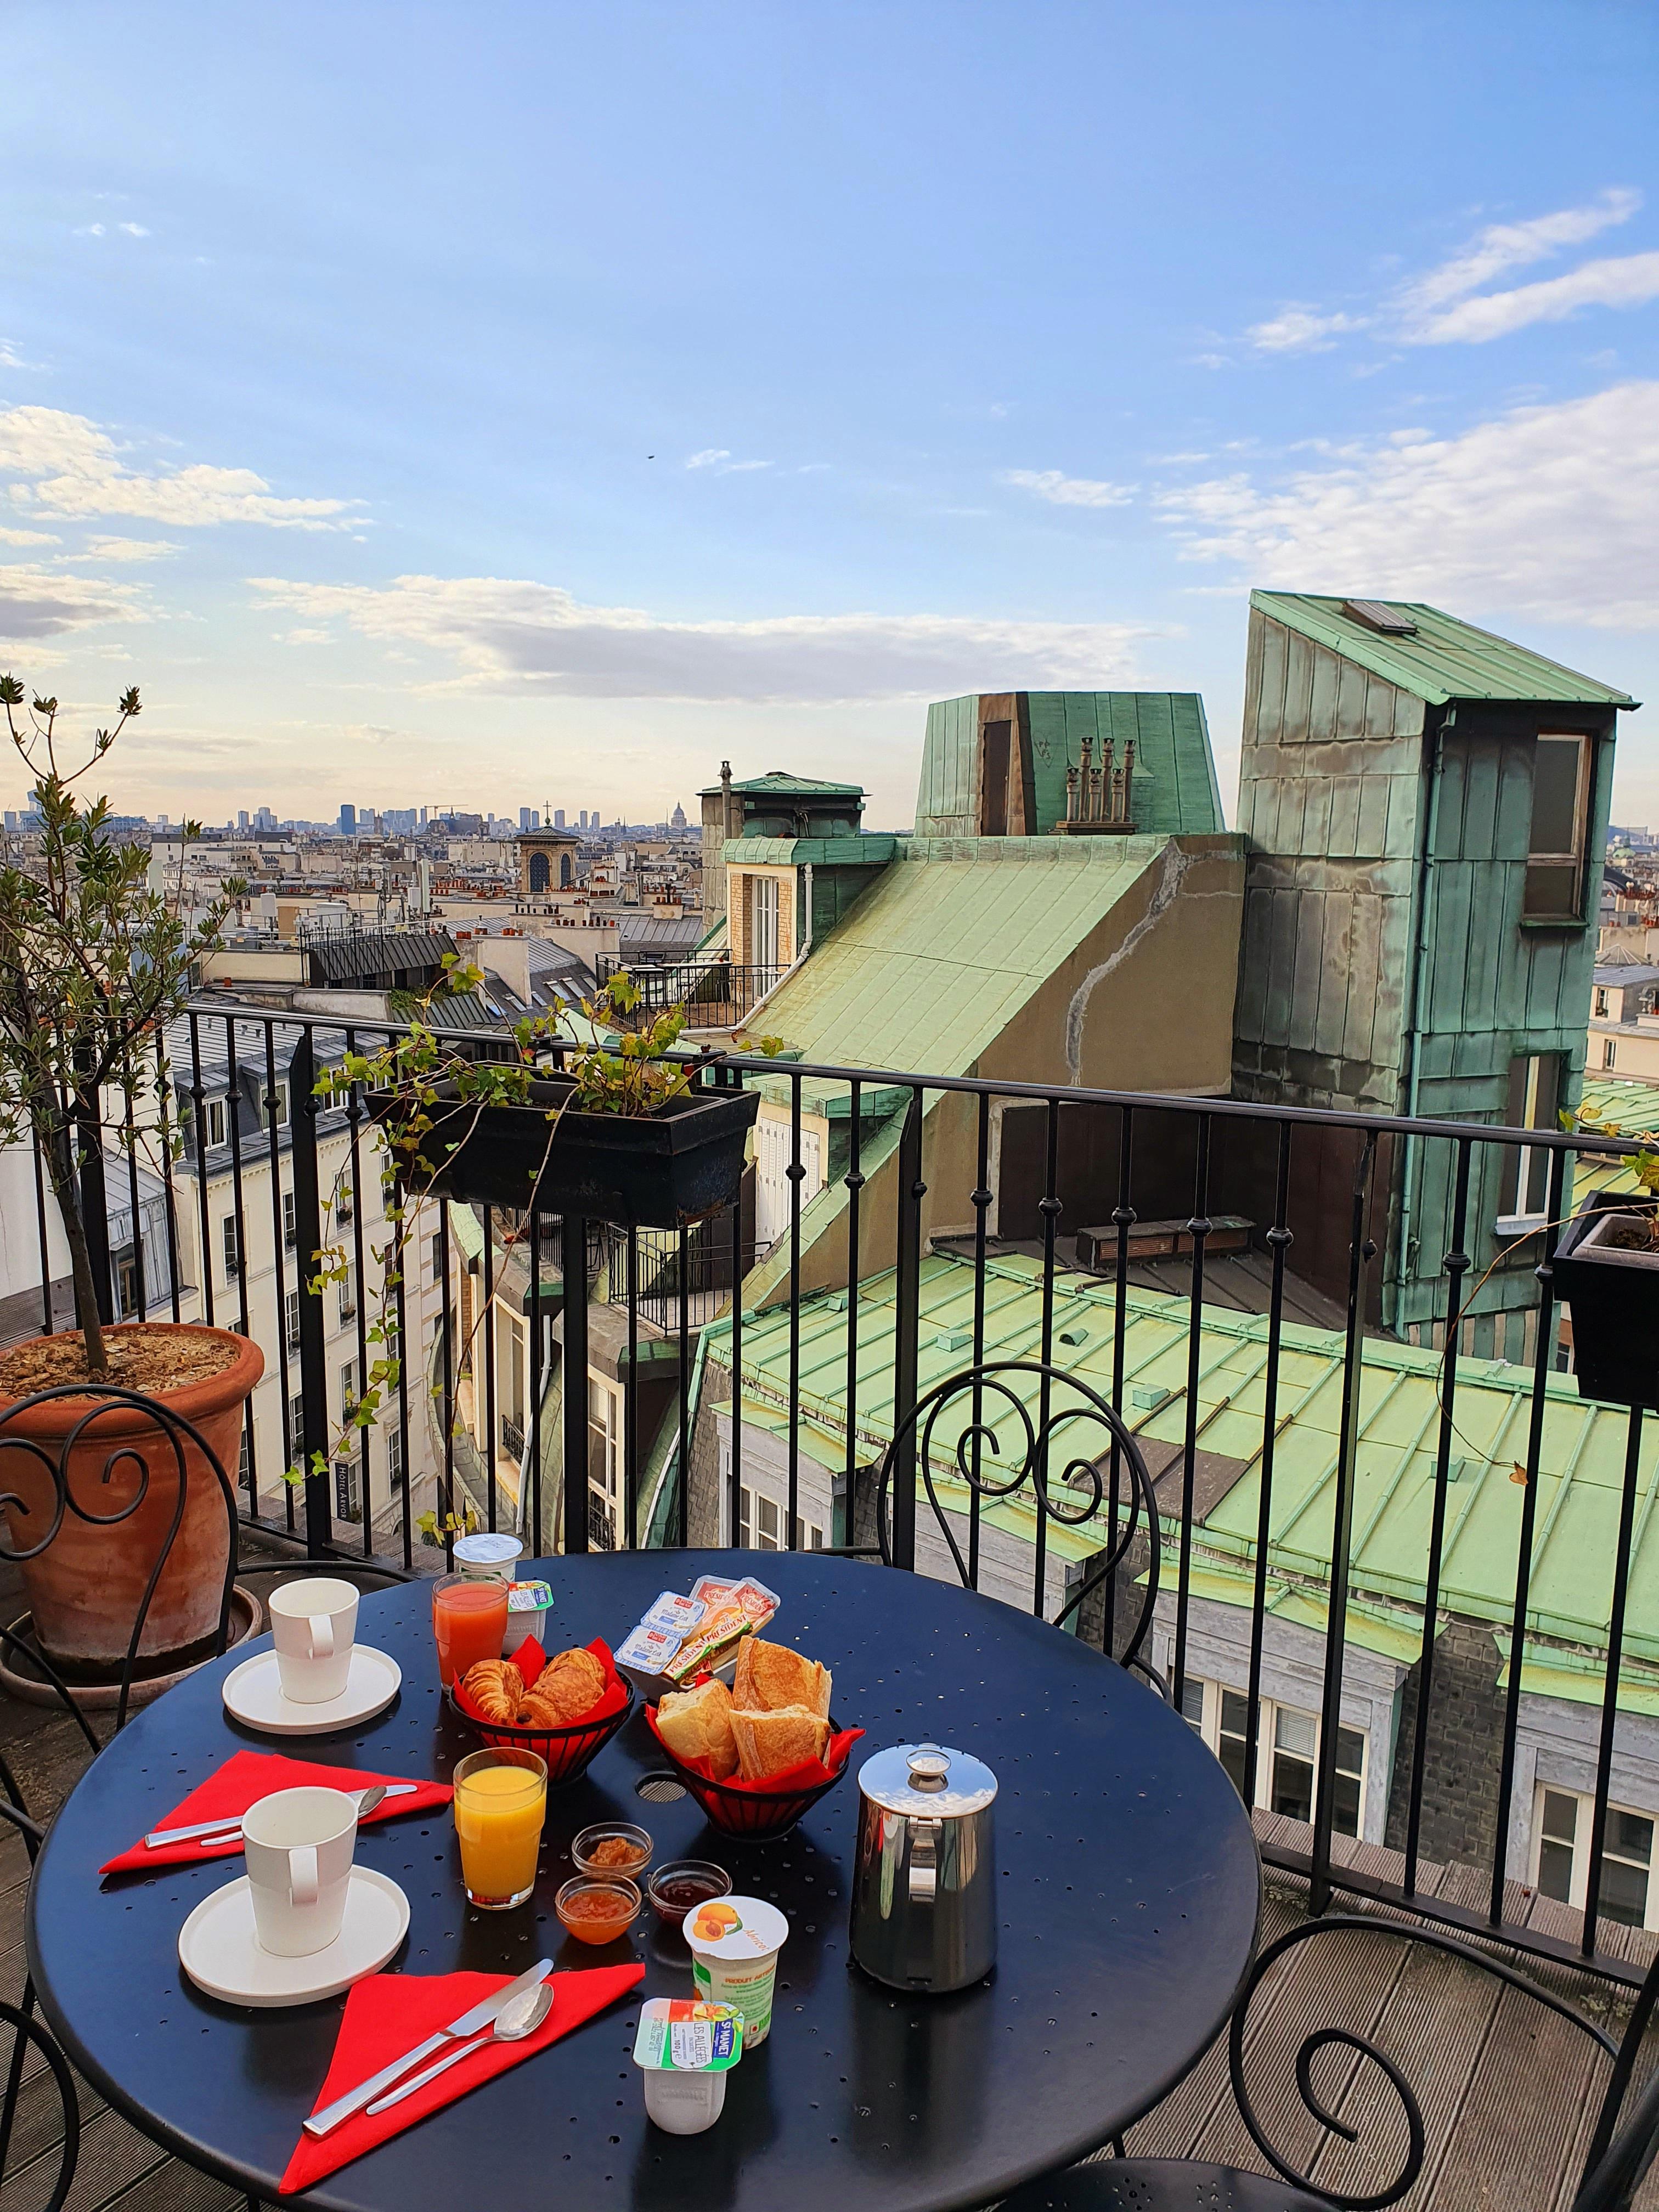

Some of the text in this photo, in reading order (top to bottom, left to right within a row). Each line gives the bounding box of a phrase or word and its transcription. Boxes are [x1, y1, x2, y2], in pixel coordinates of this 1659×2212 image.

[338, 1467, 347, 1491] HÔTEL
[742, 1929, 770, 1951] Abricot
[693, 2022, 704, 2035] LES
[718, 2030, 731, 2056] MAMET
